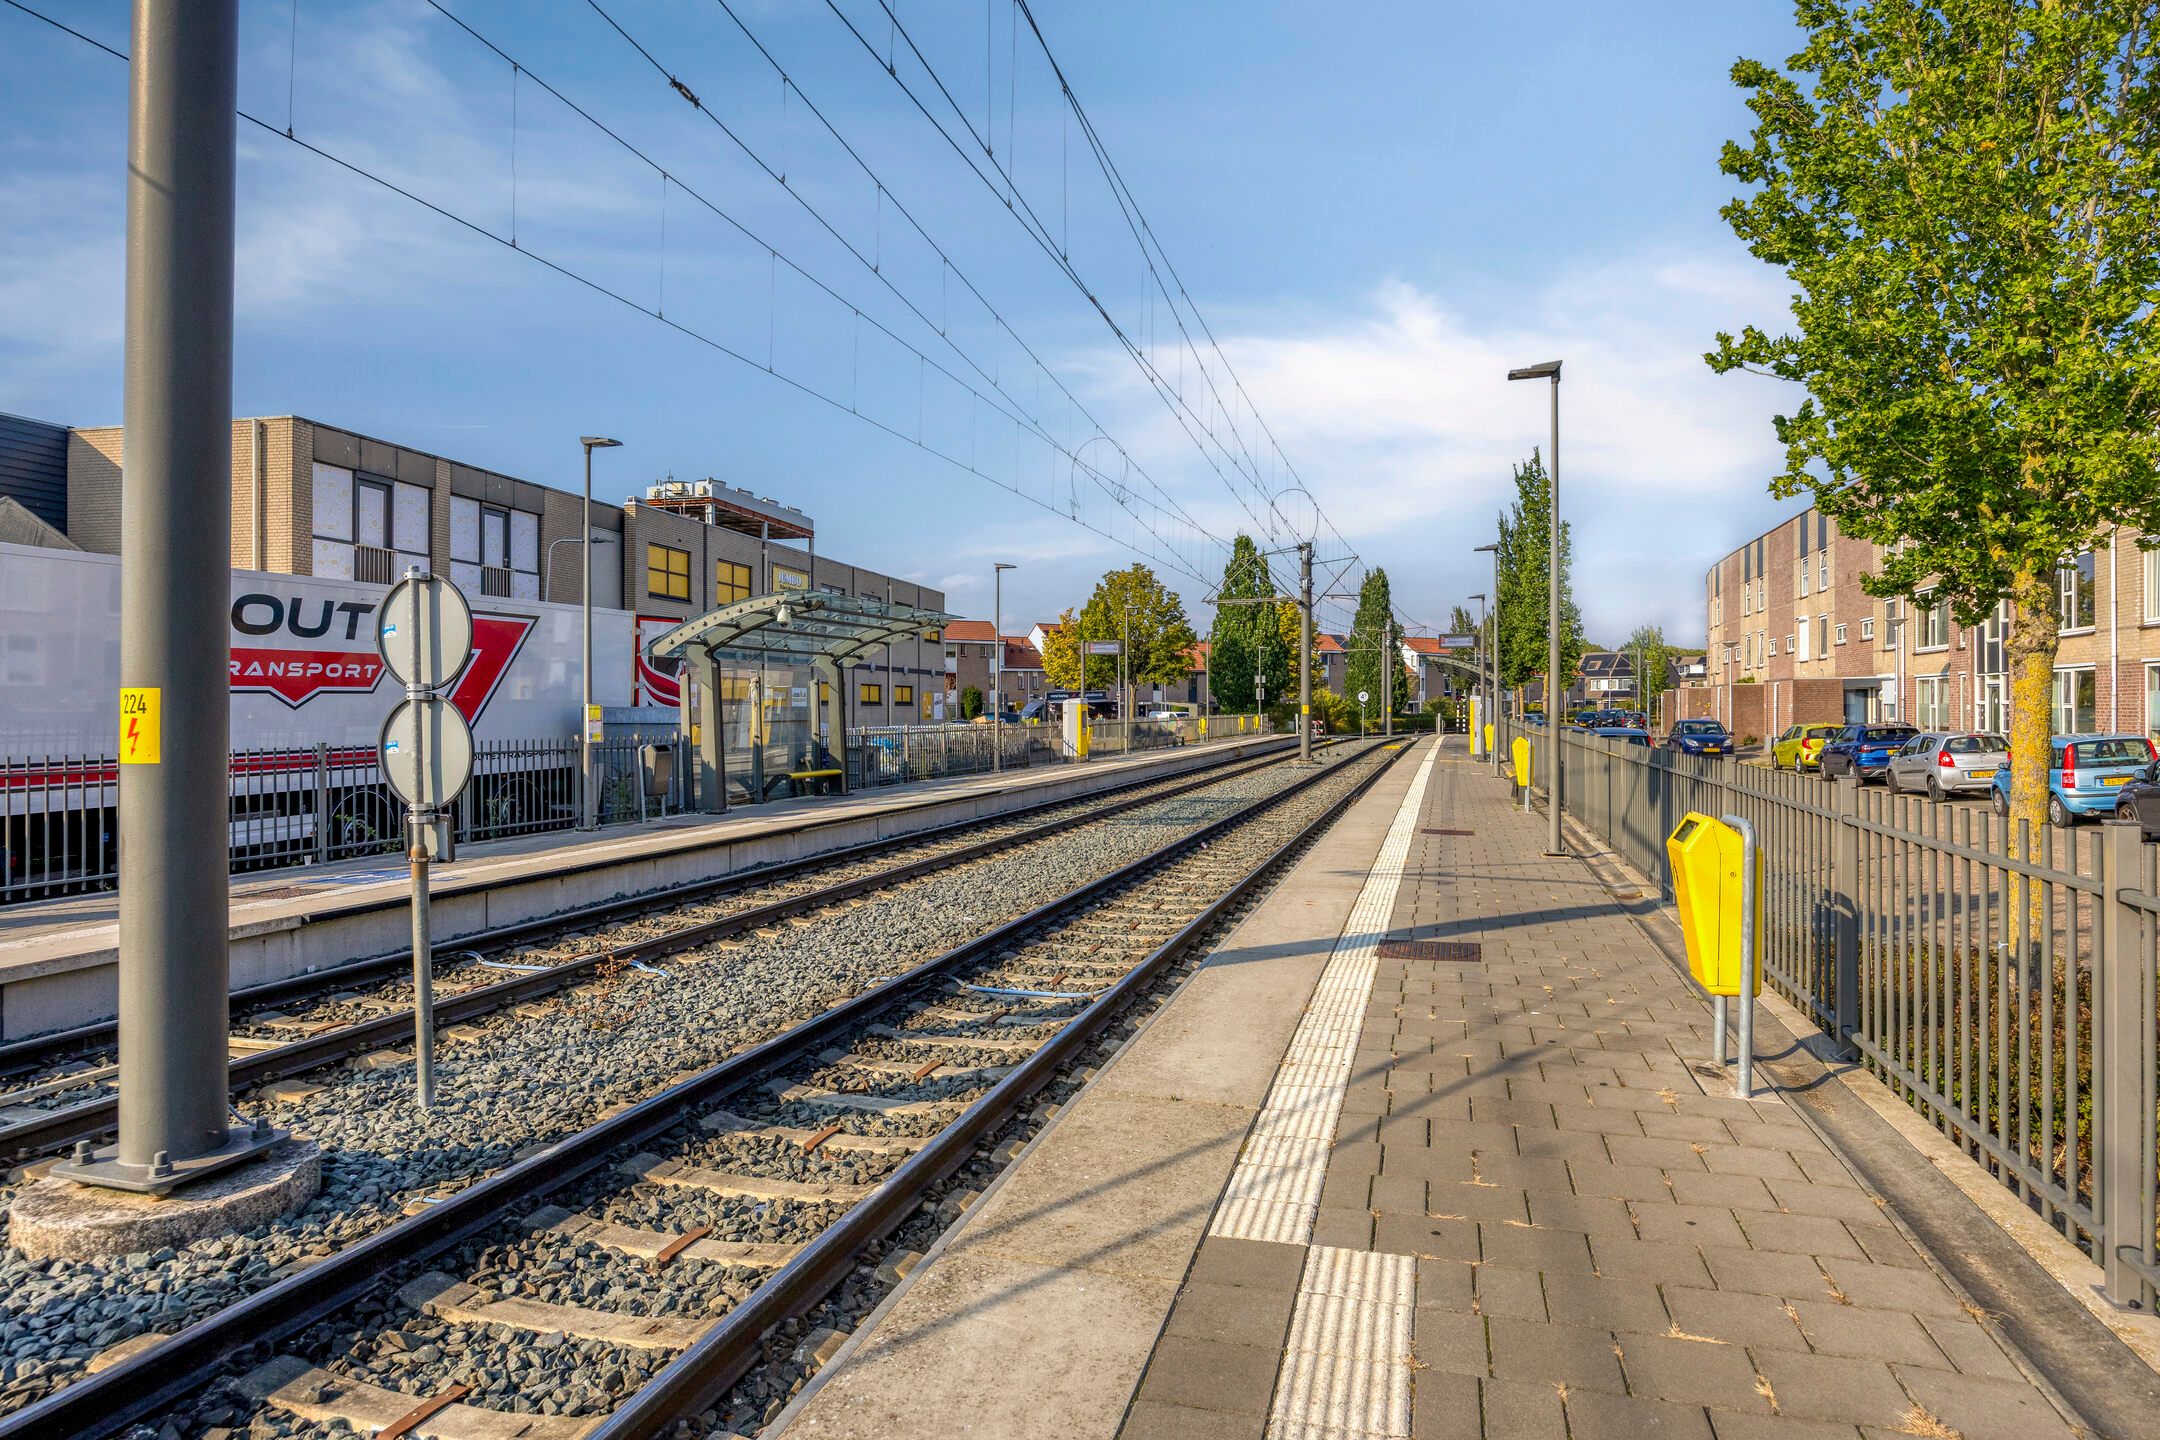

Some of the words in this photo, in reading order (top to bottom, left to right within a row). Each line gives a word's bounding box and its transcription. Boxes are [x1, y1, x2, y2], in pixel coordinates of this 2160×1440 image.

[778, 571, 802, 587] JUMBO
[231, 593, 377, 641] OUT
[230, 661, 378, 679] RANSPORT
[124, 694, 147, 714] 224
